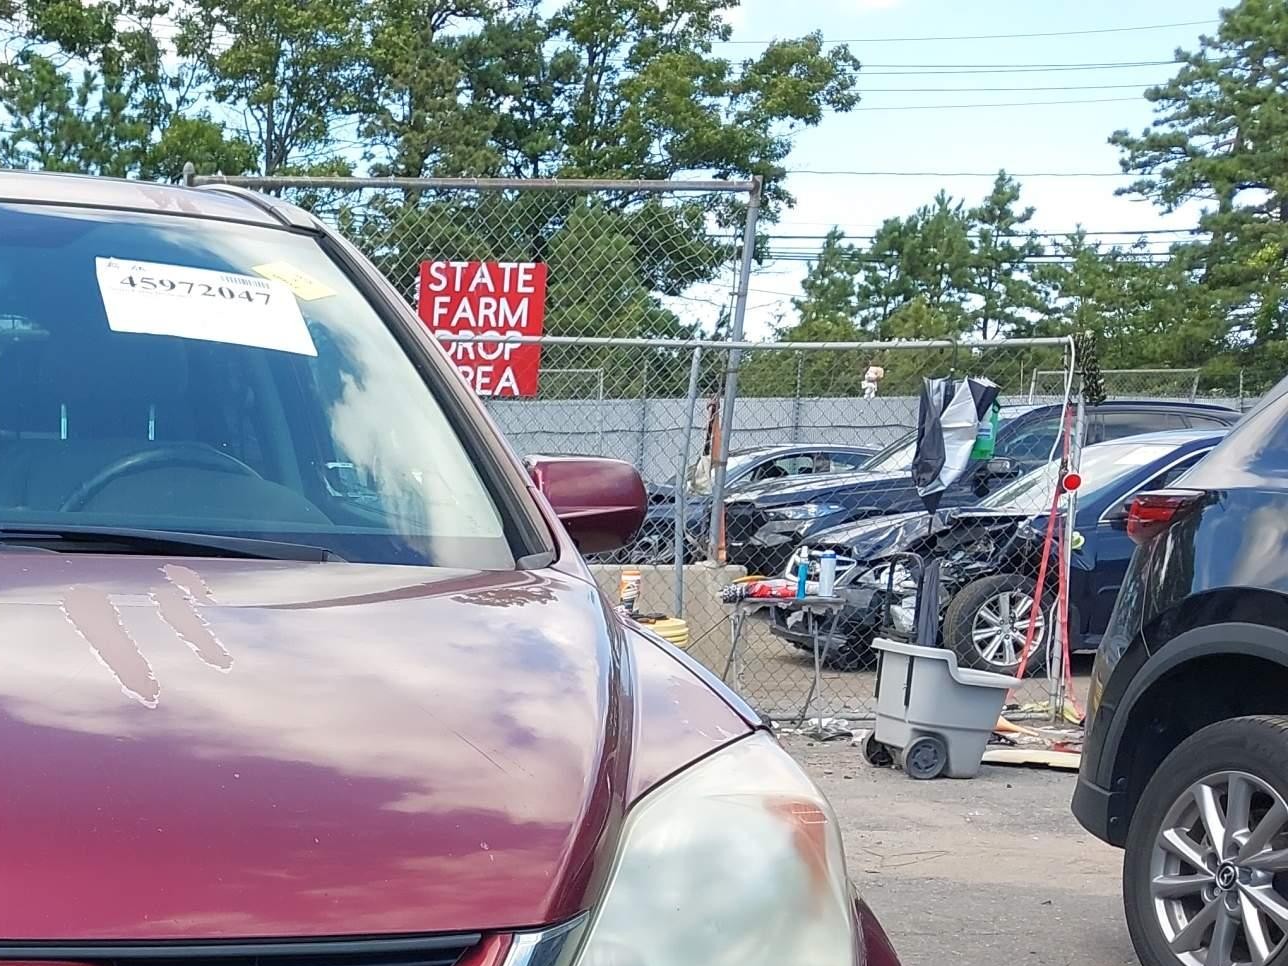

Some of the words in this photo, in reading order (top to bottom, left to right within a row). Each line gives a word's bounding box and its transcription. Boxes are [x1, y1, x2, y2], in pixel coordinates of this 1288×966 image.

[119, 275, 271, 305] 45972047
[428, 261, 536, 293] STATE
[432, 296, 529, 327] FARM
[457, 364, 520, 396] REA
